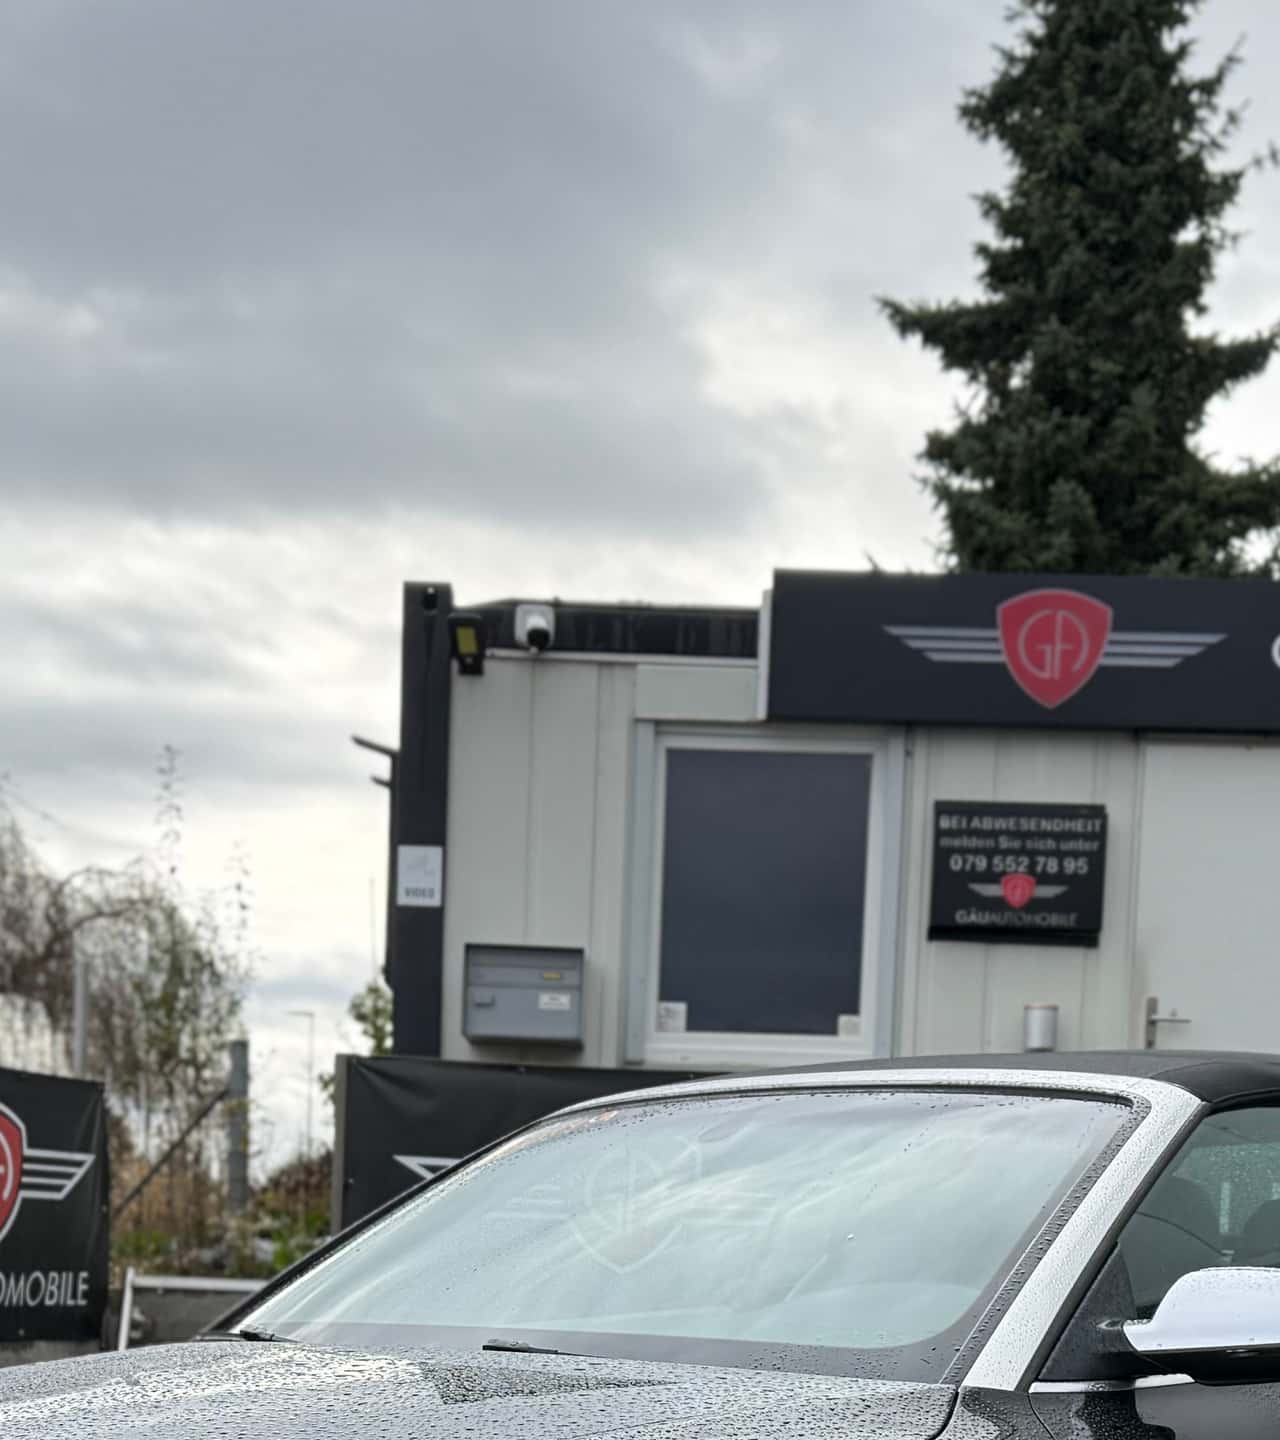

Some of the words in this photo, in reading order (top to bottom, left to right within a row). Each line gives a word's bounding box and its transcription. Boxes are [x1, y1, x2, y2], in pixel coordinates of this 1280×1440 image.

[970, 815, 1102, 833] ABWESENDHEIT
[1025, 836, 1056, 850] sich
[949, 854, 987, 872] 079
[991, 855, 1030, 873] 552
[1035, 856, 1059, 874] 78
[1063, 857, 1089, 875] 95
